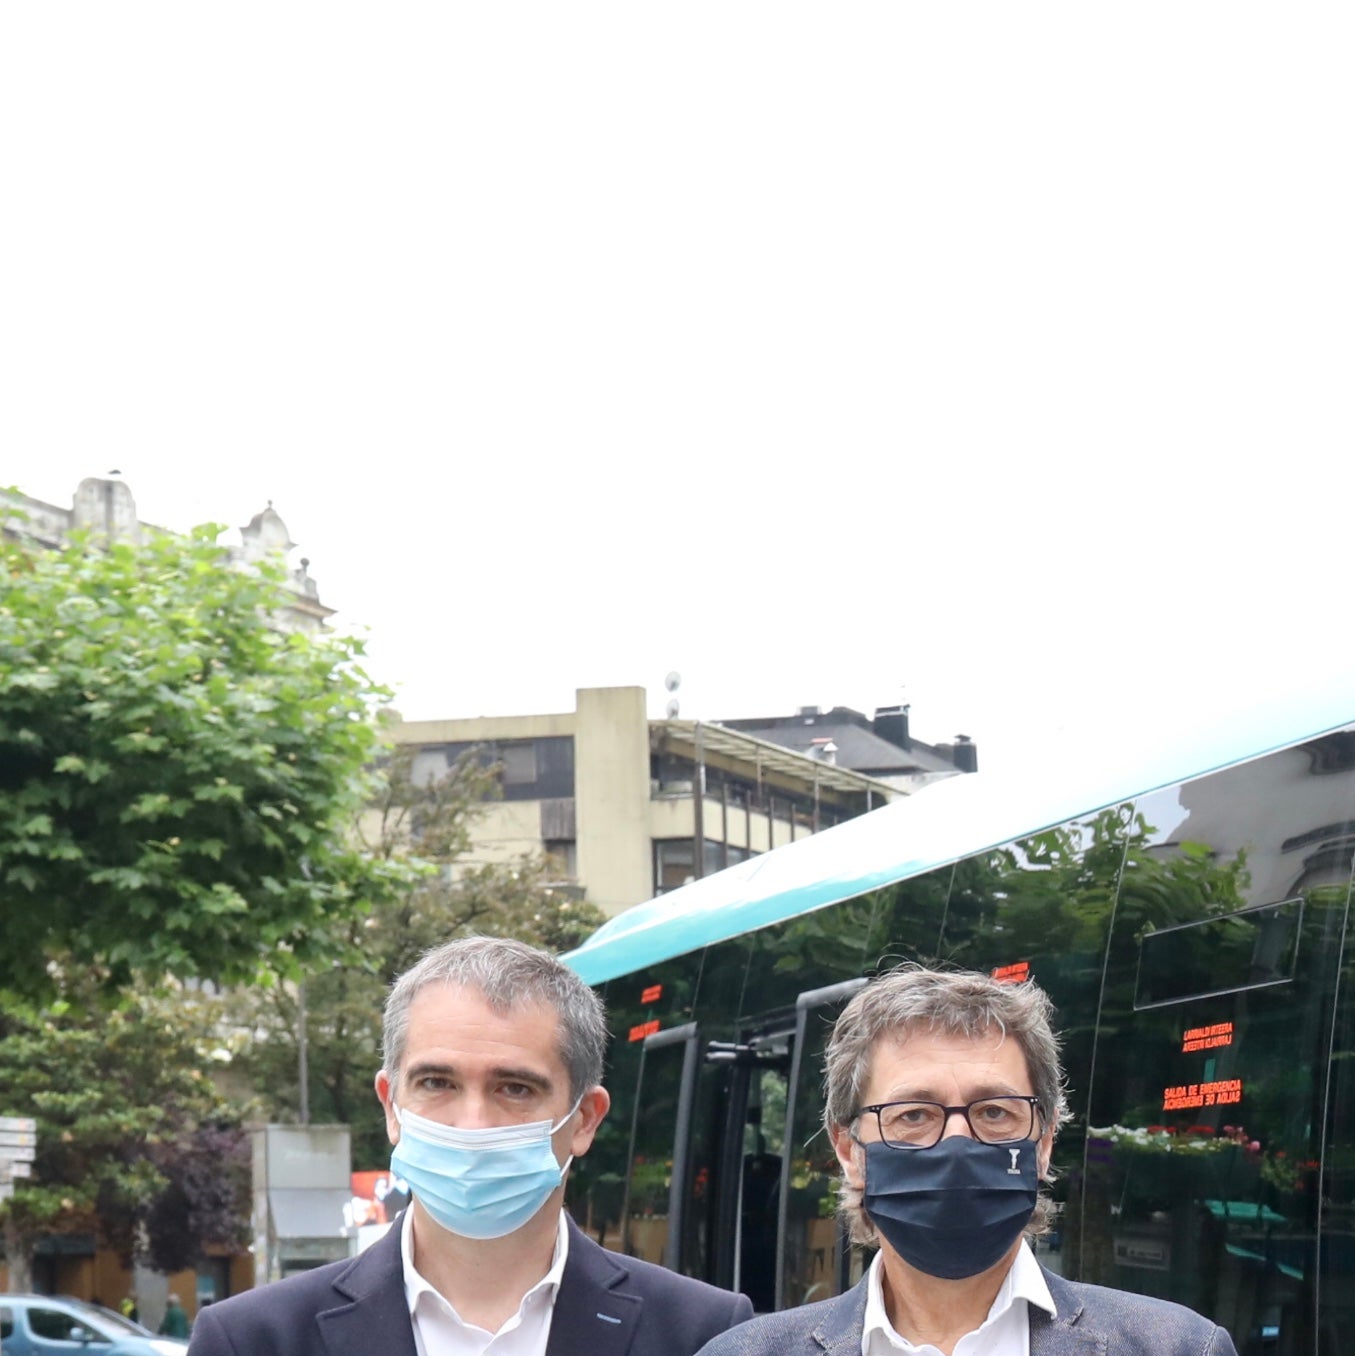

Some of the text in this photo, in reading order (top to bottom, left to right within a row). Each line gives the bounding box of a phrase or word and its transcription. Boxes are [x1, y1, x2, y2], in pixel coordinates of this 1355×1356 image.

[1164, 1079, 1242, 1099] SALIDA DE EMERGENCIA
